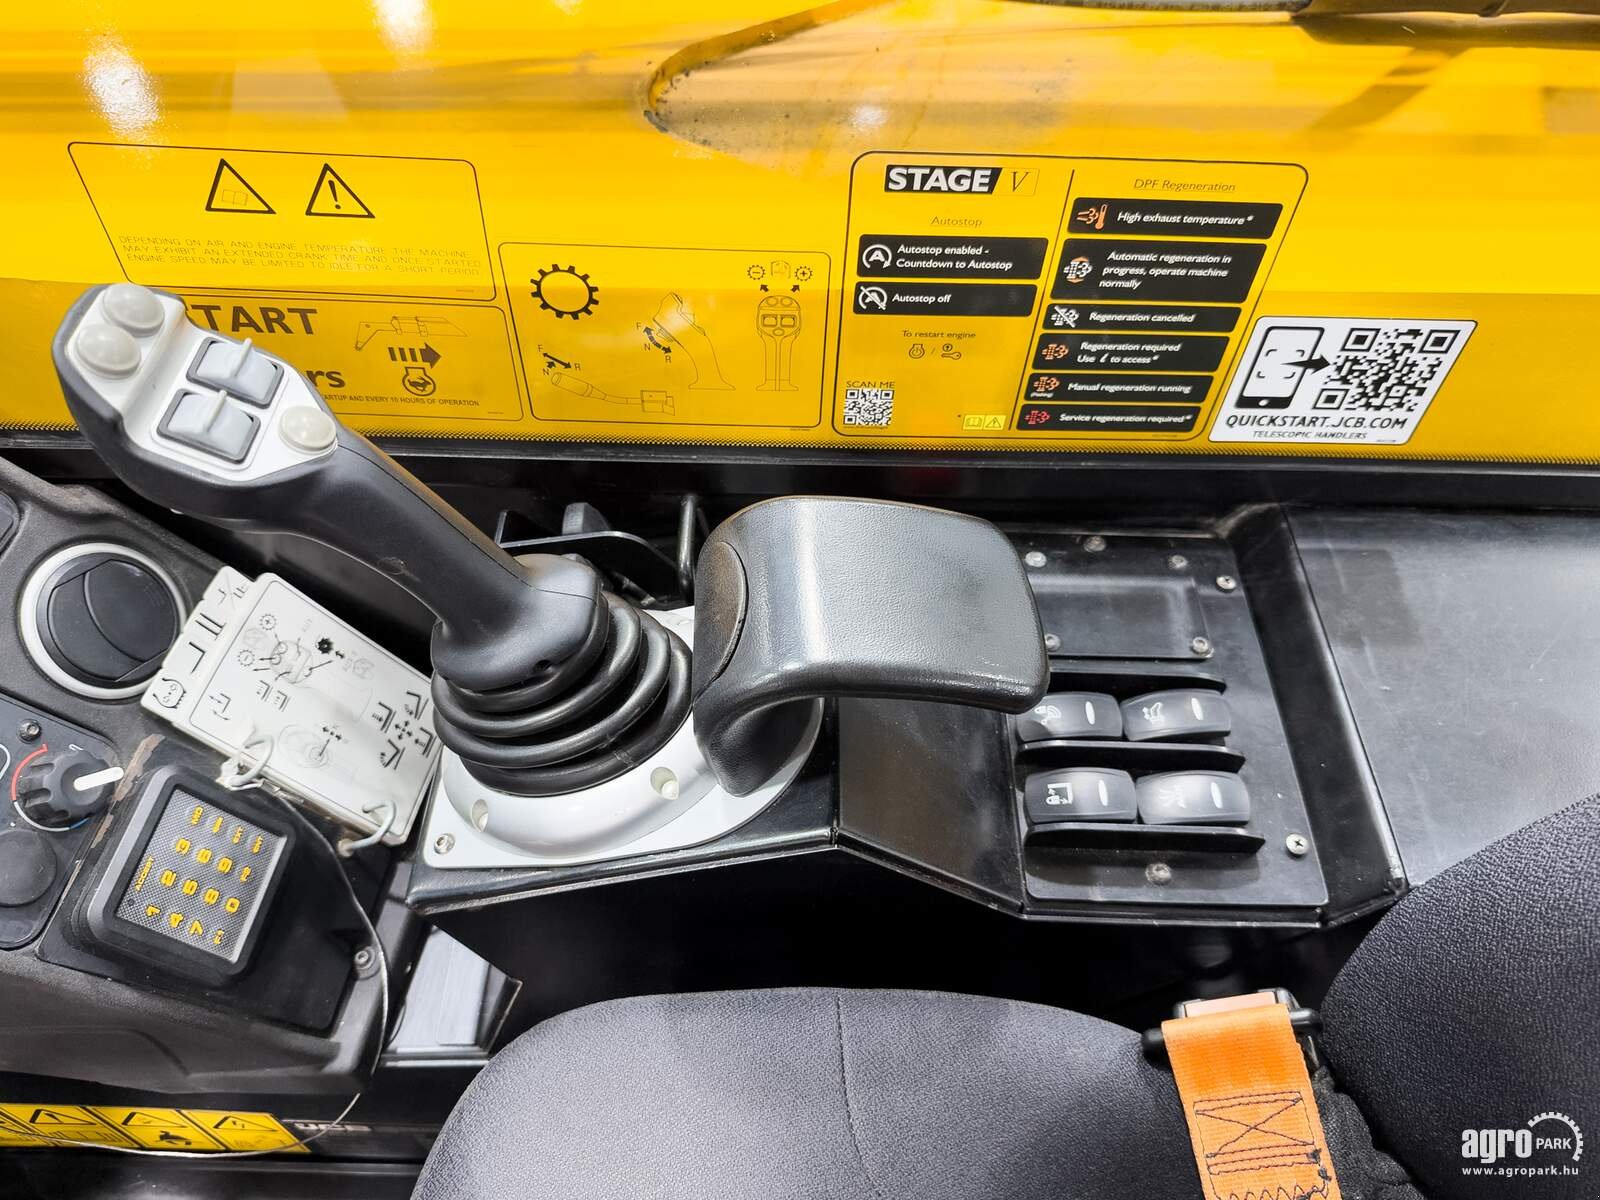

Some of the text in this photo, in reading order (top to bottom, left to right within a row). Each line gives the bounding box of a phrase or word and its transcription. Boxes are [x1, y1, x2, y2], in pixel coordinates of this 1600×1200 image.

[888, 166, 1030, 192] STAGE V
[1134, 178, 1236, 192] DPF Regeneration
[930, 216, 983, 228] Autostop
[1117, 212, 1141, 223] High
[1143, 214, 1181, 224] exhaust
[118, 236, 473, 258] DEPENDING ON AIR AND ENGINE TEMPERATURE THE MACHINE
[897, 244, 942, 256] Autostop
[944, 246, 983, 256] enabled
[122, 244, 482, 268] MAY EXHIBIT AN EXTENDED CRANK TIME AND ONCE STARTED
[1107, 251, 1232, 264] Automatic regeneration in
[126, 254, 165, 262] ENGINE
[170, 256, 206, 264] SPEED
[210, 256, 237, 265] MAY
[242, 258, 257, 266] BE
[261, 258, 304, 268] LIMITED
[311, 261, 326, 269] TO
[329, 262, 354, 271] IDLE
[357, 264, 379, 272] FOR
[400, 264, 433, 274] SHORT
[440, 267, 480, 276] PERIOD
[896, 258, 1012, 271] Countdown to Autostop
[1102, 266, 1228, 278] progress, operate machine
[1099, 279, 1142, 290] normally
[892, 293, 952, 304] Autostop off
[186, 304, 318, 335] TART
[1088, 312, 1196, 324] Regeneration cancelled
[636, 322, 642, 331] F
[902, 330, 976, 340] To restart engine
[538, 344, 544, 354] F
[644, 342, 651, 352] N
[1080, 342, 1182, 354] Regeneration required
[664, 355, 672, 364] R
[1077, 354, 1096, 364] Use
[1110, 356, 1121, 364] to
[542, 368, 550, 376] N
[574, 362, 582, 372] R
[846, 380, 877, 388] SCAN
[1067, 382, 1192, 394] Manual regeneration running
[438, 398, 480, 406] OPERATION
[1058, 413, 1091, 422] Service
[1092, 414, 1148, 424] regeneration
[1225, 414, 1408, 430] QUICKSTART.JCB.COM
[1253, 430, 1368, 440] TELESCOPIC HANDLERS
[146, 904, 160, 917] 1
[160, 869, 177, 888] 2
[168, 912, 184, 928] 4
[182, 879, 199, 896] 5
[189, 920, 204, 936] 7
